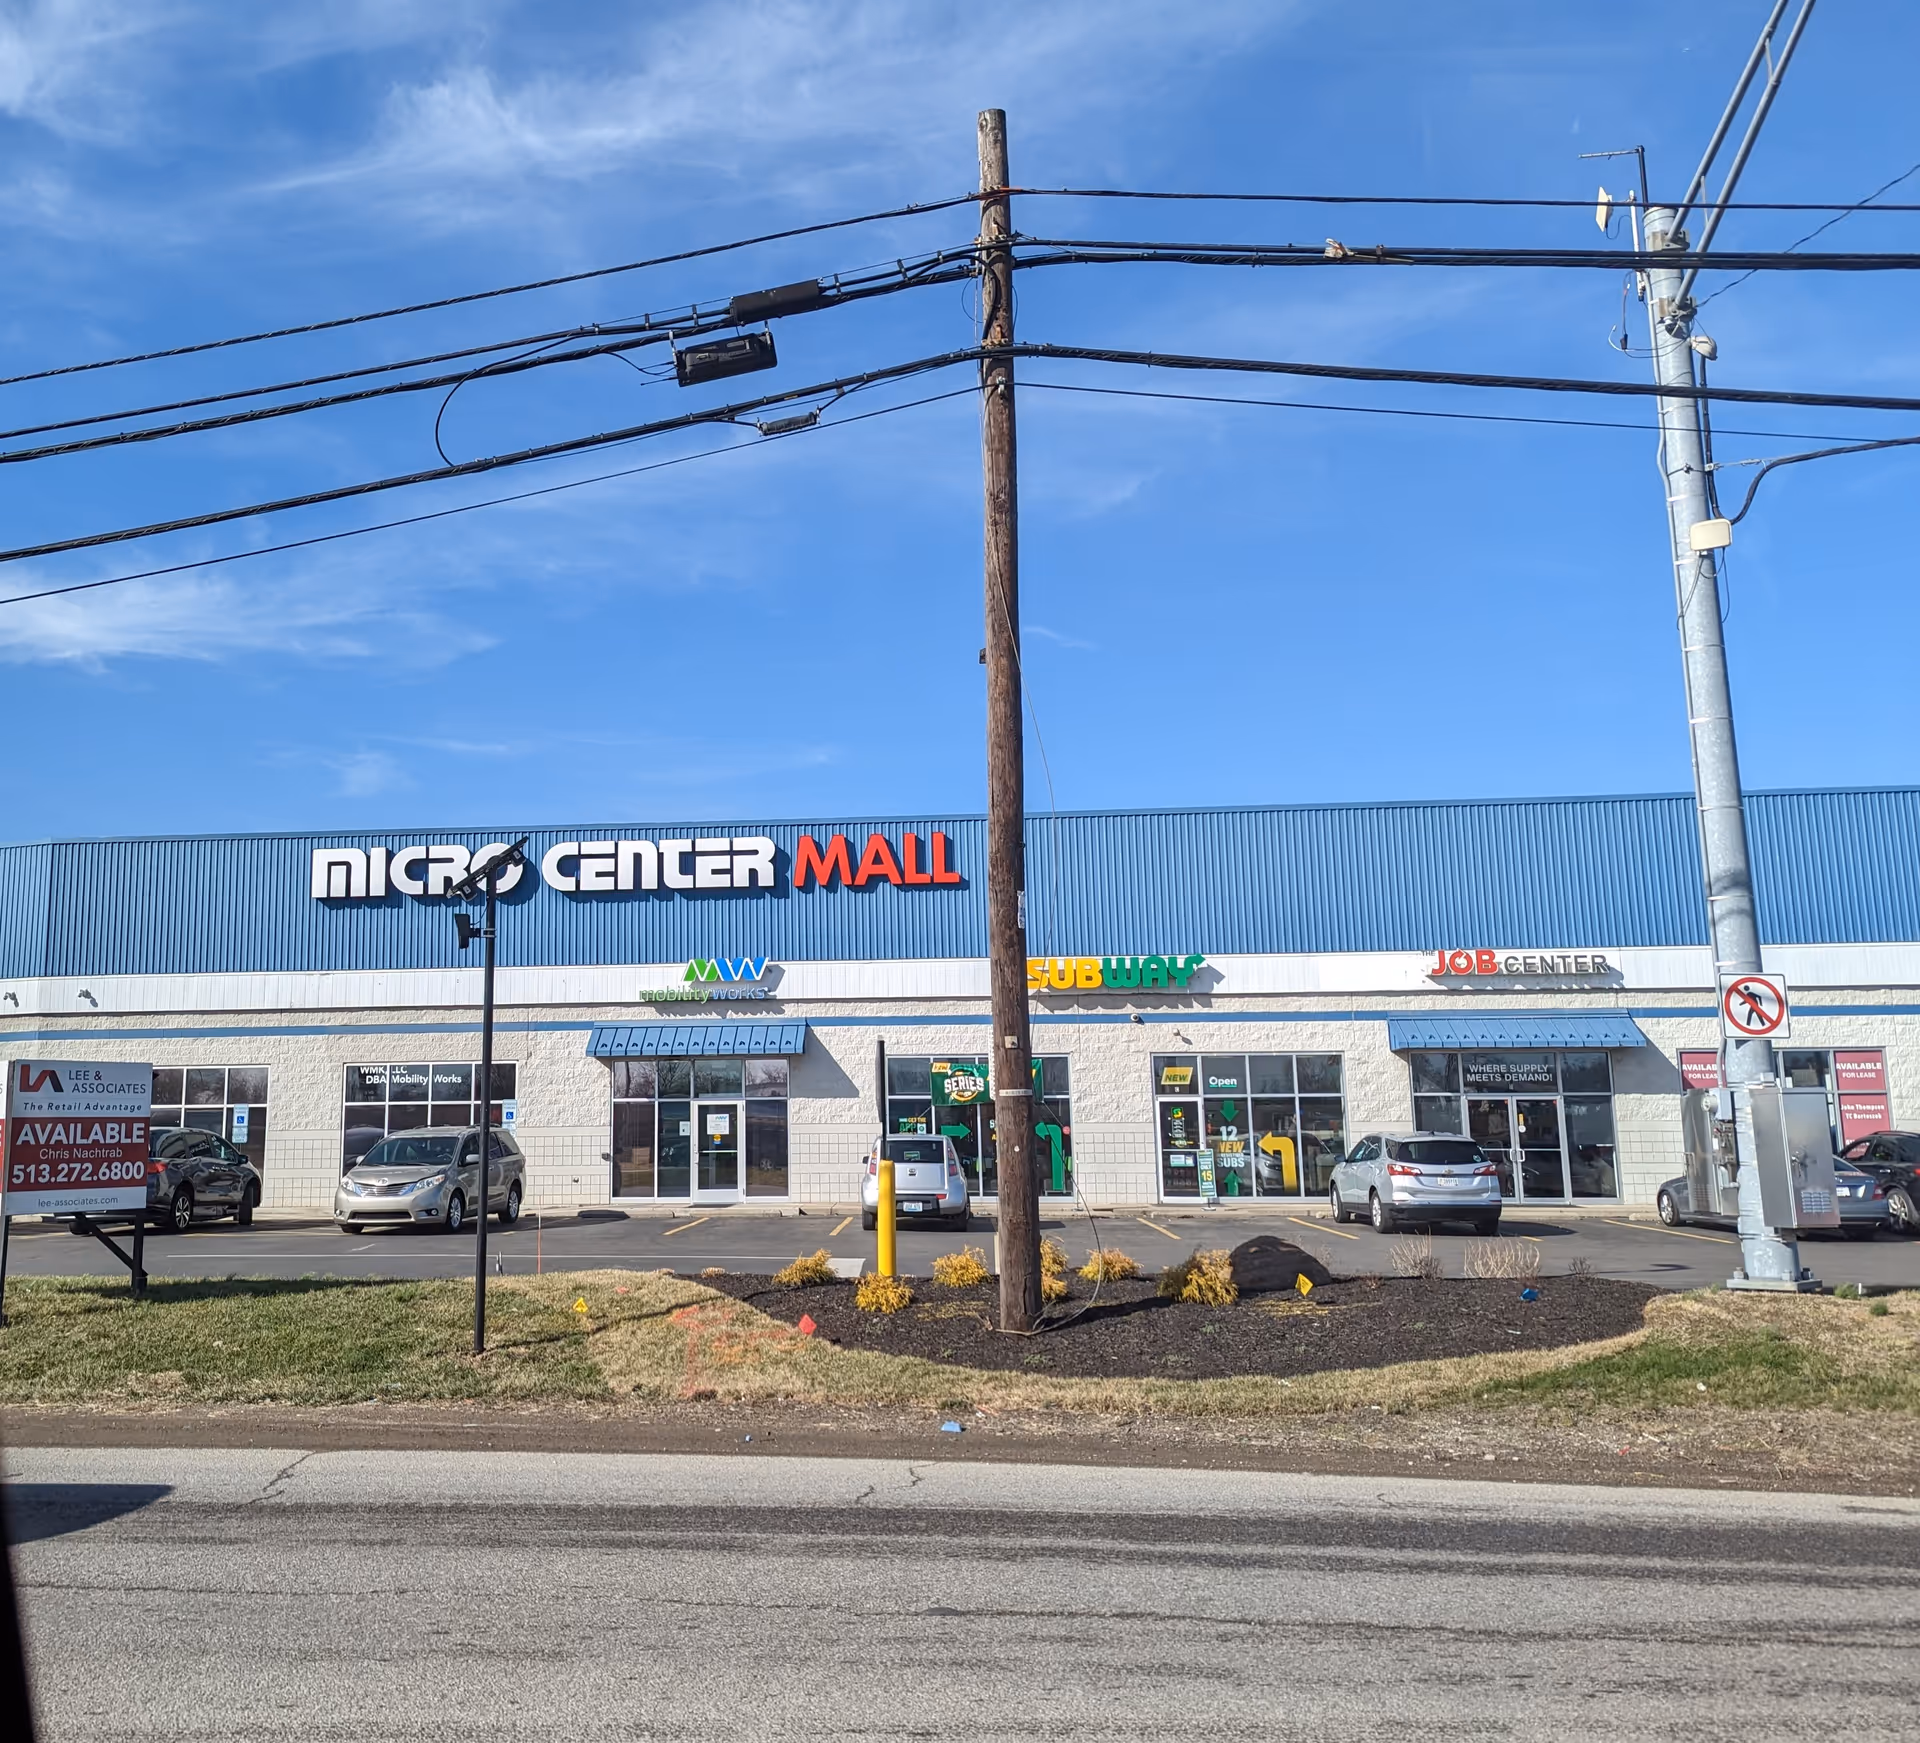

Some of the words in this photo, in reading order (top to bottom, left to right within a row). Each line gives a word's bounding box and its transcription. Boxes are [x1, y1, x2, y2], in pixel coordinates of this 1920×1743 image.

[312, 842, 524, 898] MICRO
[541, 836, 776, 891] CENTER
[793, 831, 961, 887] MALL
[1431, 949, 1498, 976] JOB
[1504, 954, 1610, 975] CENTER
[1026, 953, 1206, 990] SUBWAY
[1469, 1064, 1507, 1073] WHERE
[1510, 1064, 1549, 1073] SUPPLY
[1682, 1063, 1725, 1071] AVAILAB
[1836, 1062, 1882, 1070] AVAILABLE
[68, 1070, 90, 1081] LEE
[94, 1070, 103, 1081] &
[366, 1075, 387, 1084] DBA
[391, 1074, 429, 1086] Mobility
[433, 1074, 462, 1083] Works
[1165, 1074, 1188, 1082] NEW
[1466, 1073, 1501, 1082] MEETS
[1504, 1073, 1553, 1082] DEMAND!
[944, 1075, 985, 1094] SERIES
[1209, 1076, 1238, 1087] Open
[71, 1083, 147, 1094] ASSOCIATES
[23, 1102, 43, 1111] The
[47, 1102, 81, 1111] Retail
[84, 1102, 142, 1112] Advantage
[15, 1122, 146, 1146] AVAILABLE
[1220, 1125, 1238, 1141] 12
[1217, 1141, 1245, 1153] NEW
[39, 1148, 70, 1160] Chris
[73, 1147, 123, 1159] Nachtrab
[1217, 1157, 1245, 1168] SUBS
[11, 1161, 145, 1185] 513.272.6800
[1201, 1170, 1213, 1182] 15
[38, 1197, 119, 1208] lee-associates.com
